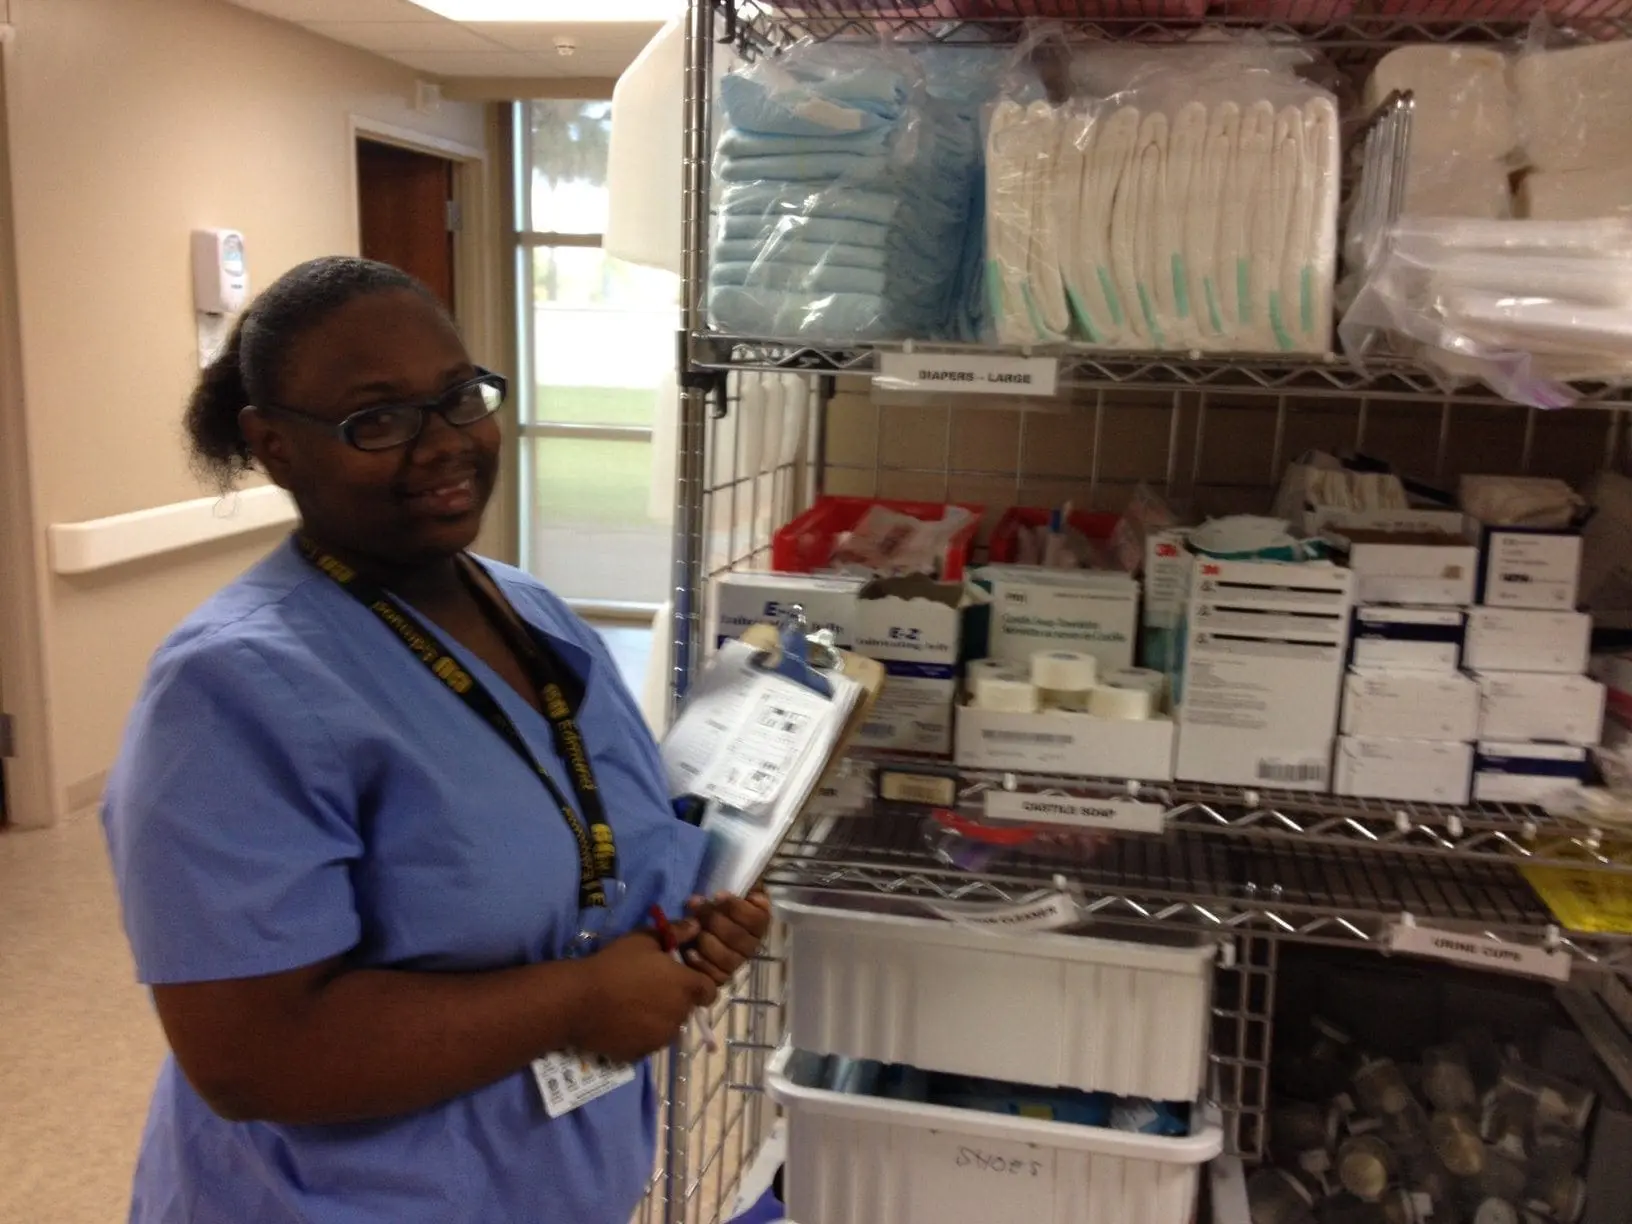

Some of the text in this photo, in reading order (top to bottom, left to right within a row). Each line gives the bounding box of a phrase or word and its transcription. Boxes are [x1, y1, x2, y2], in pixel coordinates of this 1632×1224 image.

[918, 369, 975, 383] DIAPERS
[987, 372, 1032, 385] LARGE
[1156, 543, 1177, 557] 3M
[1202, 564, 1221, 576] 3M
[889, 626, 922, 640] E-Z
[1433, 935, 1523, 963] URINE CUPS
[955, 1144, 1044, 1177] SHOES
